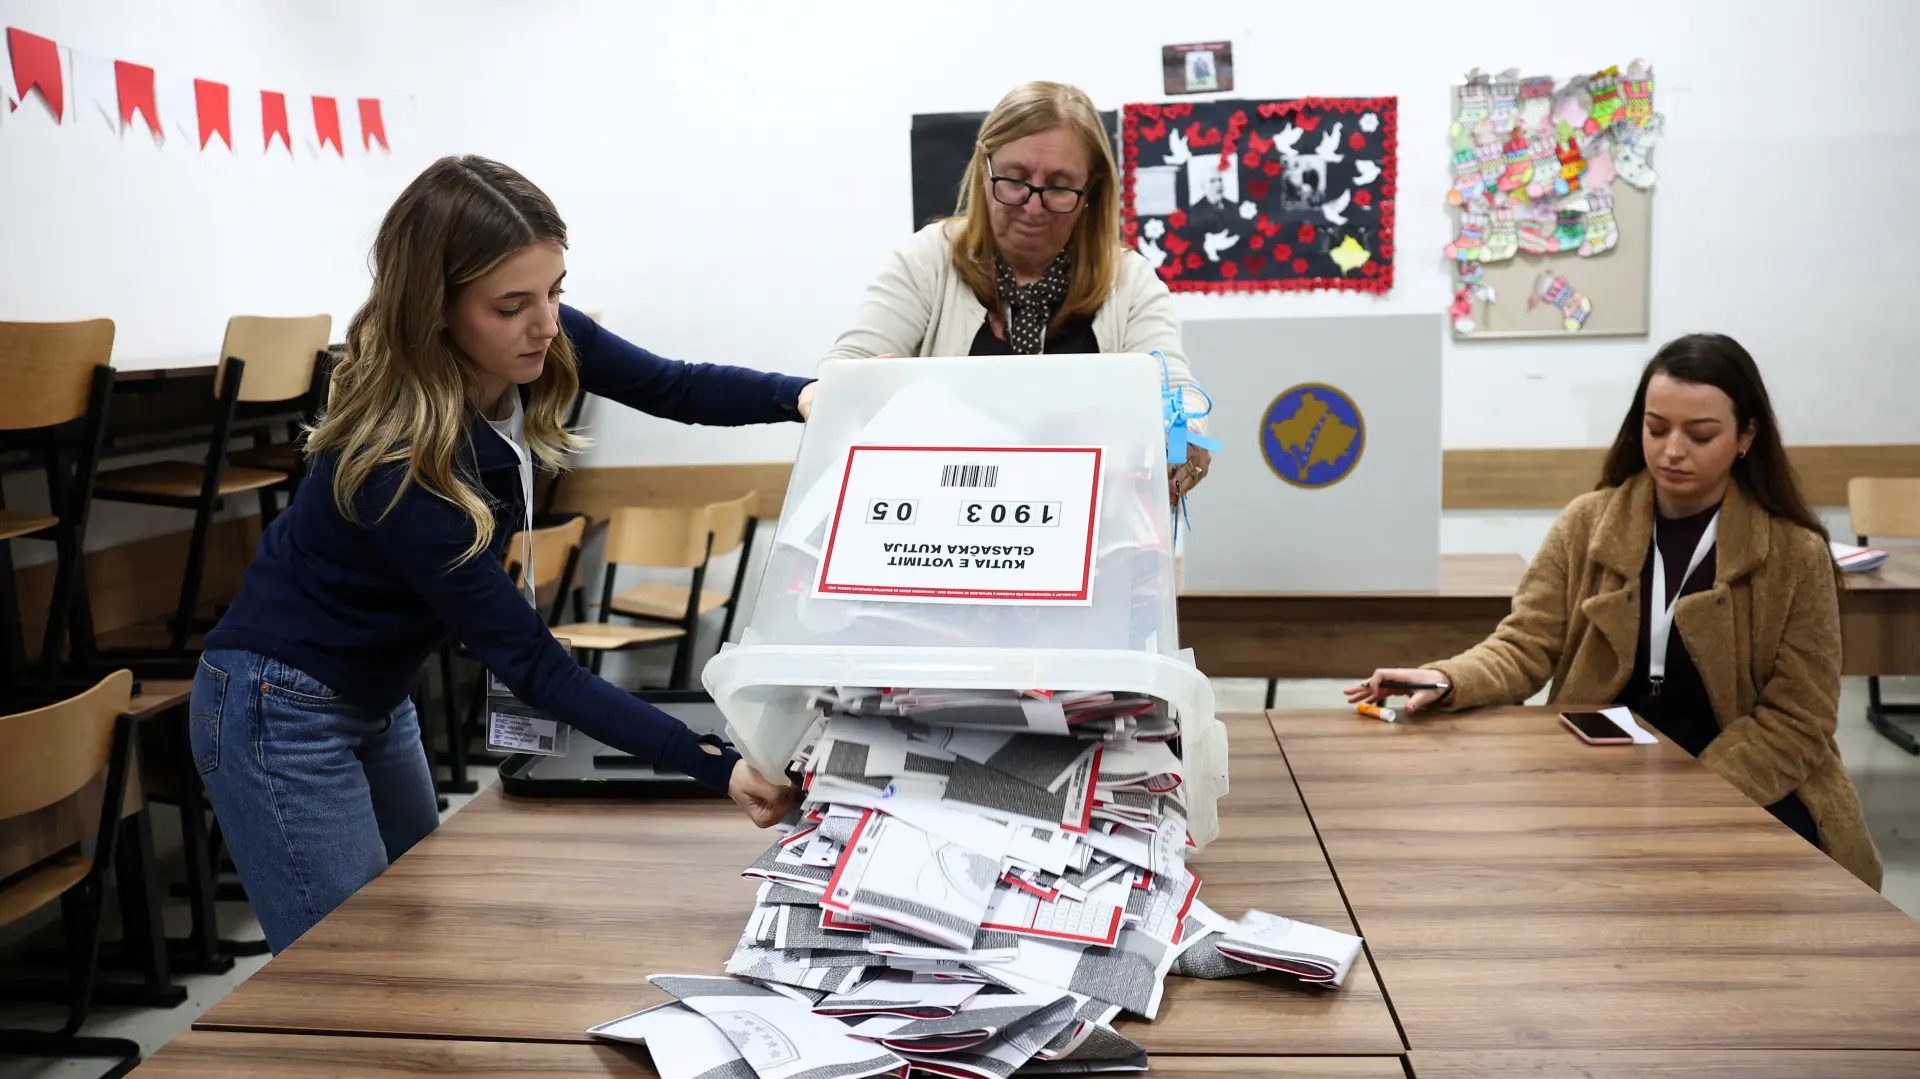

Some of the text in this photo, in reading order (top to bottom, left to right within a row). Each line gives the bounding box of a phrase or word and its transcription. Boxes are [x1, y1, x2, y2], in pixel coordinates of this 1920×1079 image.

[872, 501, 1054, 524] 1903 05
[883, 543, 1035, 557] GLASAČKA KUTIJA
[887, 556, 1026, 569] KUTIA E VOTIMIT
